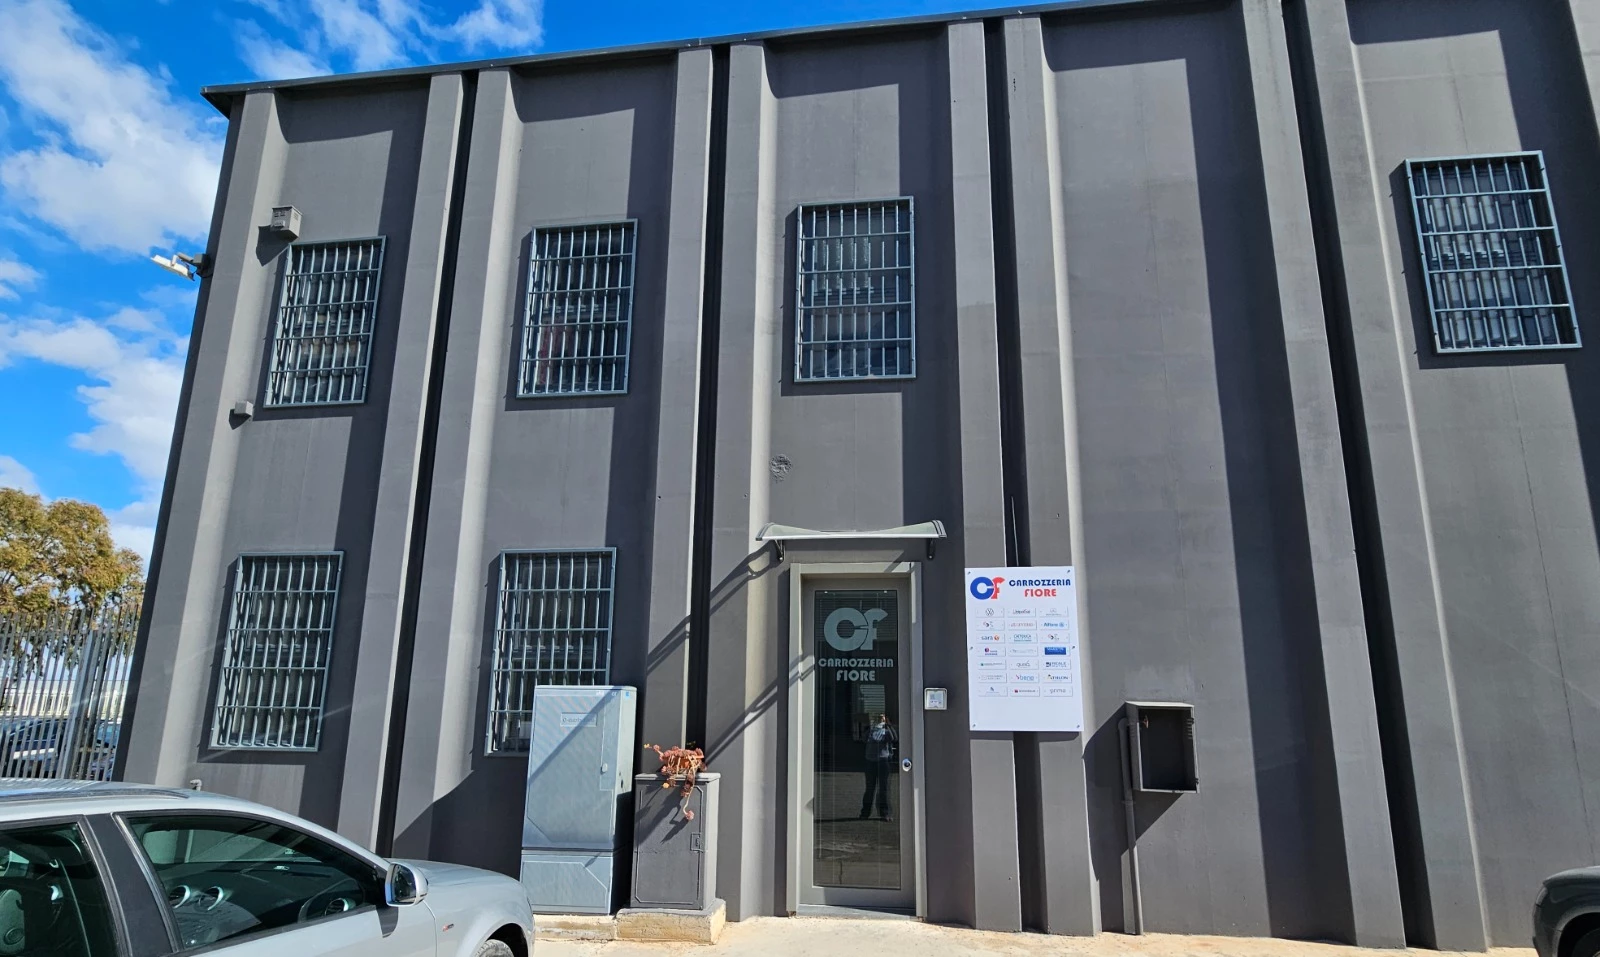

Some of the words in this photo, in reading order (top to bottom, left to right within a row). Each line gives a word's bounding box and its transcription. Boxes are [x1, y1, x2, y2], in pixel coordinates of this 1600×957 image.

[1024, 588, 1057, 597] FIORE
[818, 658, 894, 668] CARROZZERIA
[836, 669, 876, 682] FIORE
